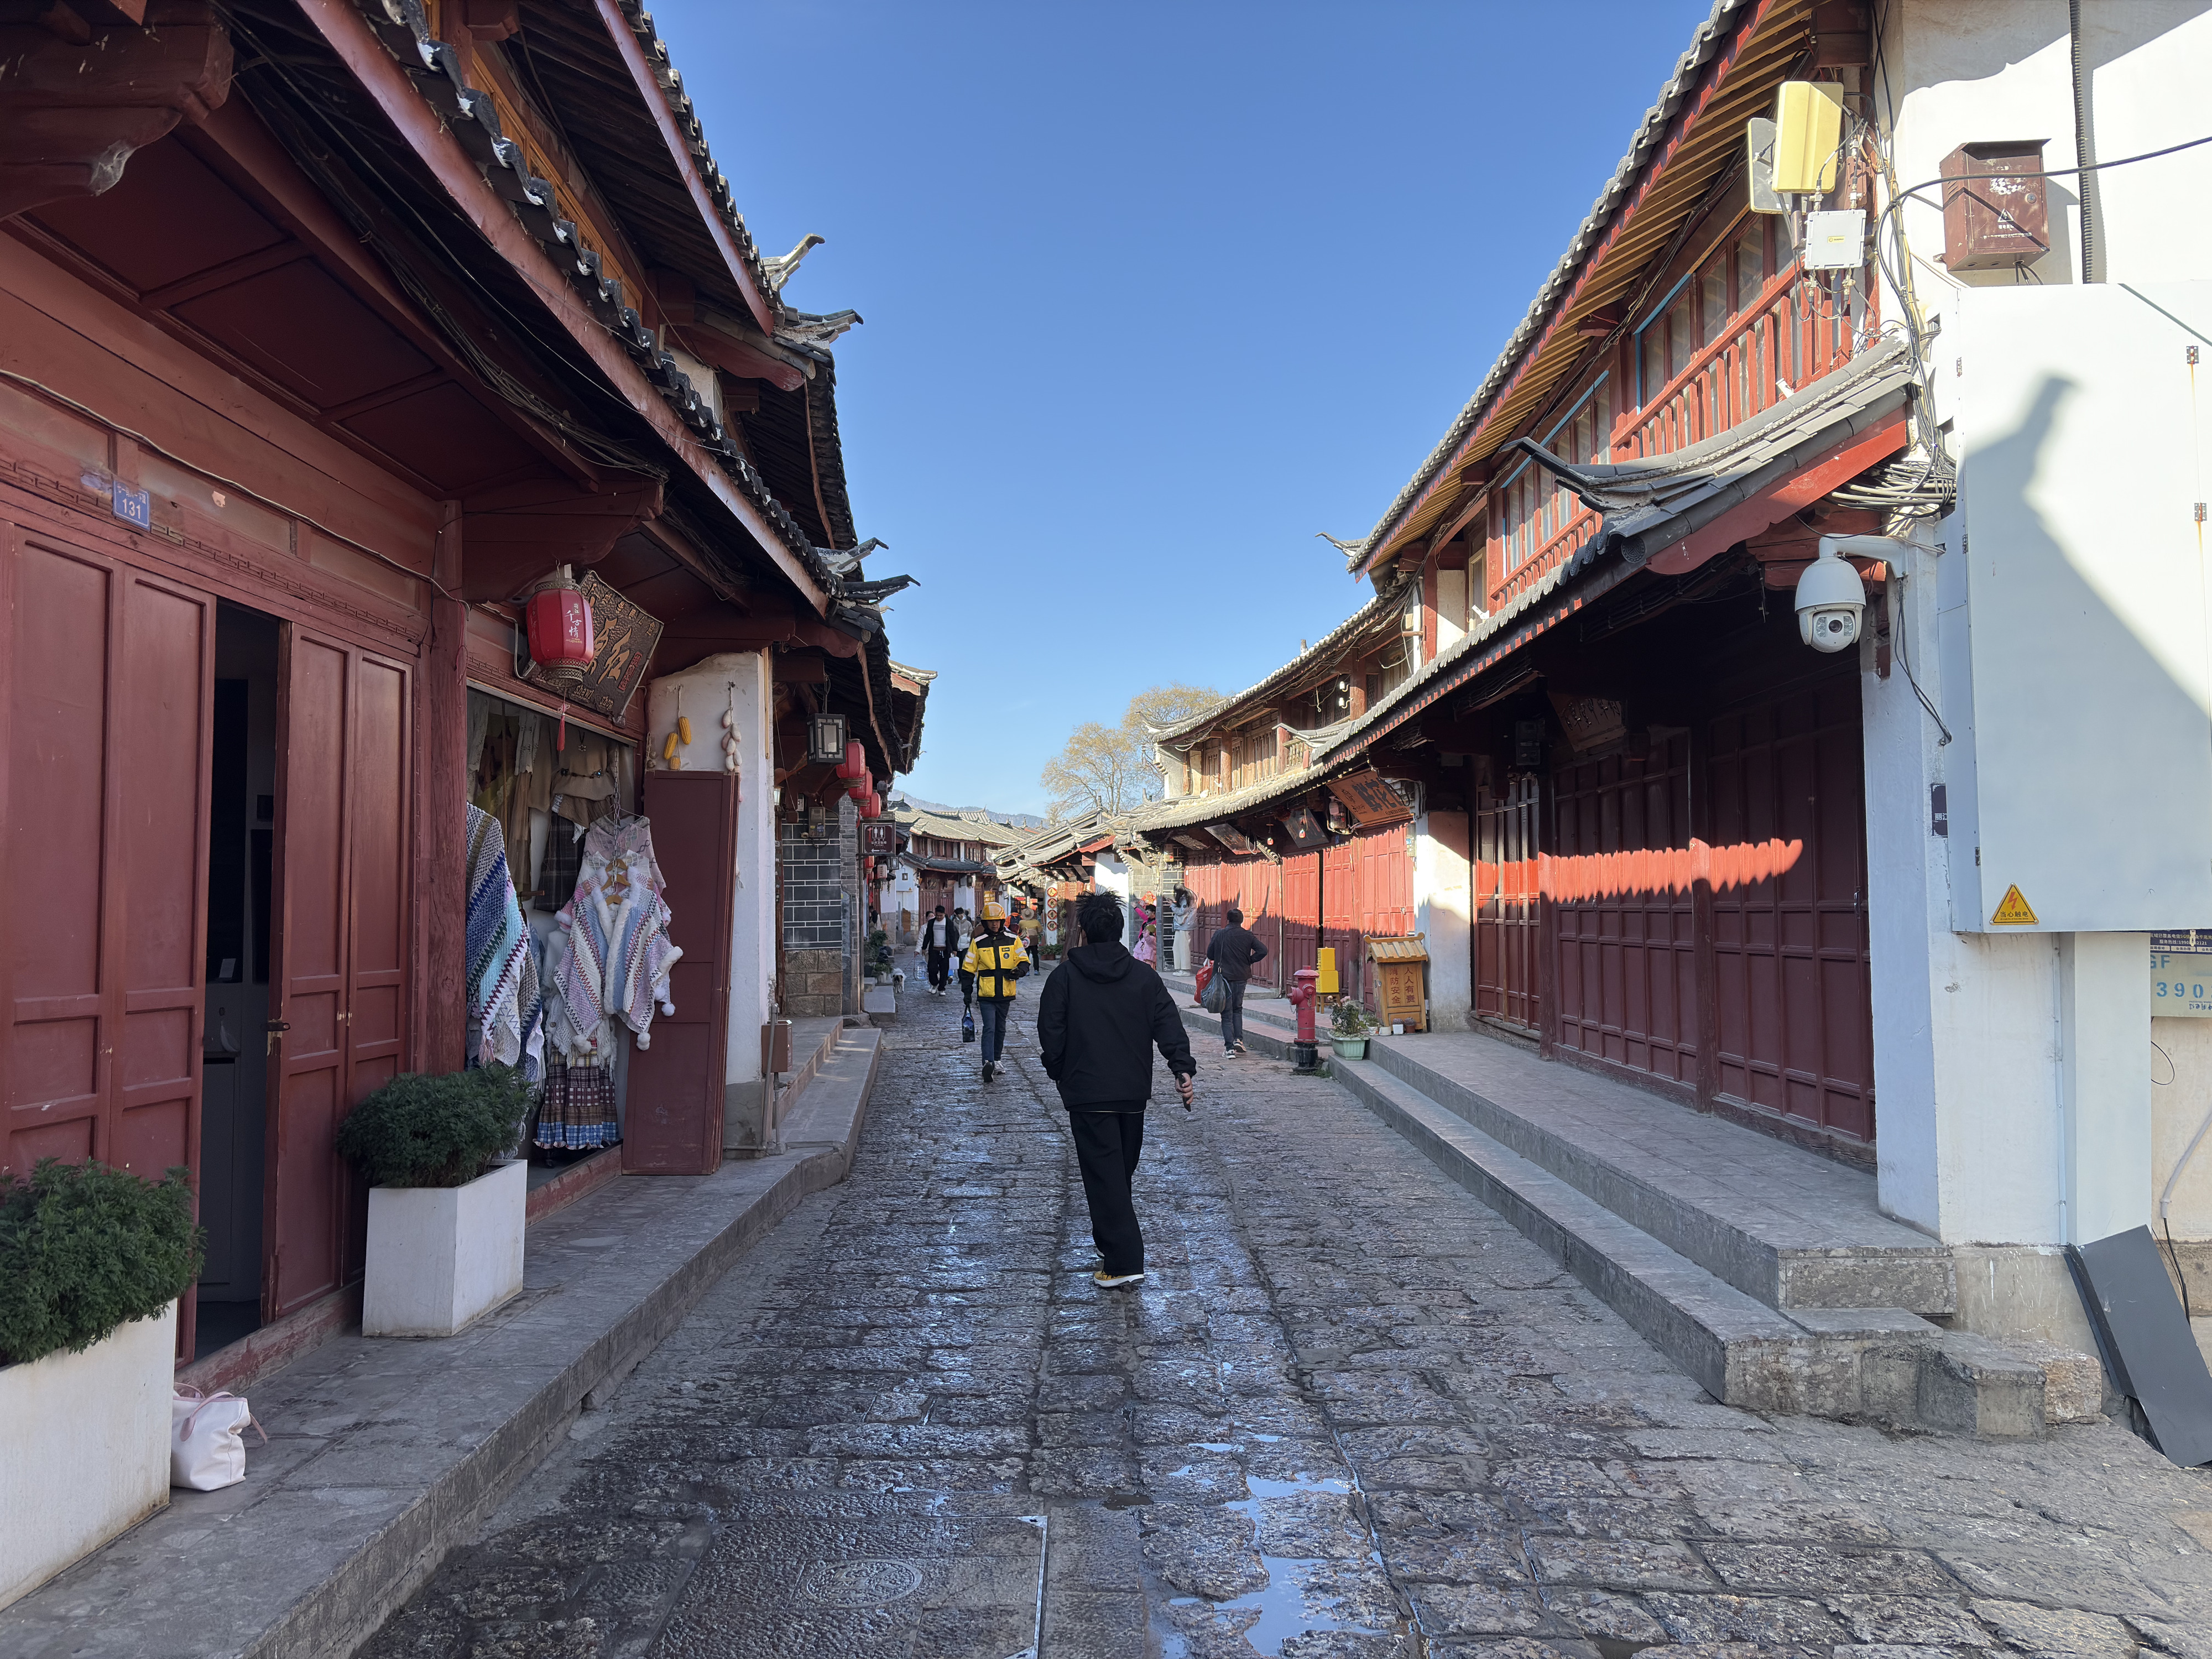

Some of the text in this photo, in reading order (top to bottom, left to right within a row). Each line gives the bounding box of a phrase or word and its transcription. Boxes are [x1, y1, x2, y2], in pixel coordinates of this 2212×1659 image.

[122, 498, 140, 519] 131
[565, 610, 582, 638] 千古情
[600, 696, 614, 709] shop
[1389, 967, 1401, 1004] 消防安全
[1404, 967, 1416, 1003] 人人有责
